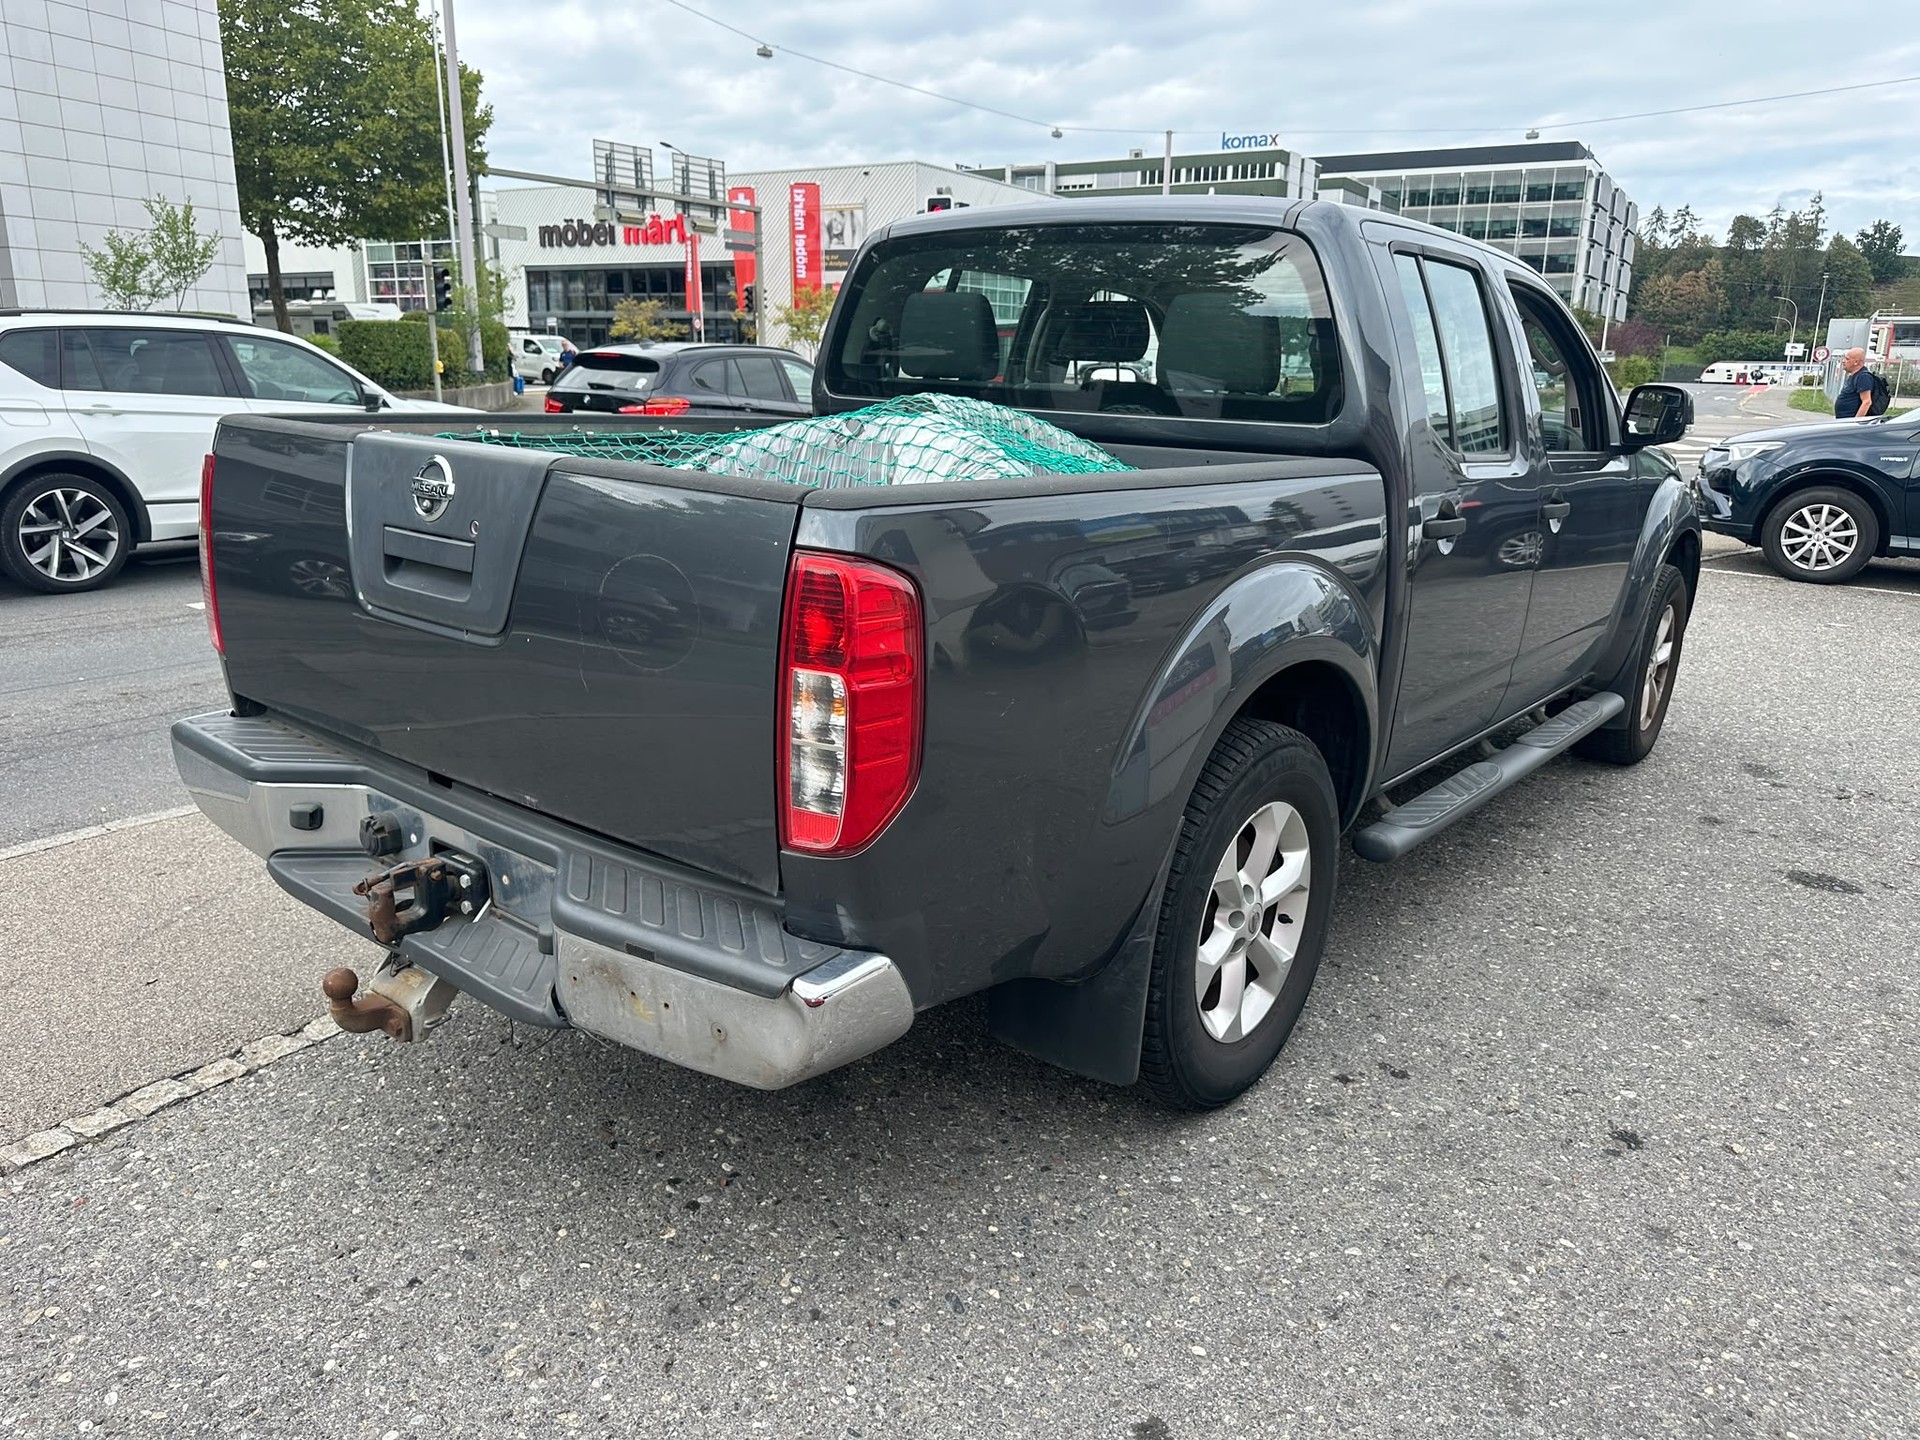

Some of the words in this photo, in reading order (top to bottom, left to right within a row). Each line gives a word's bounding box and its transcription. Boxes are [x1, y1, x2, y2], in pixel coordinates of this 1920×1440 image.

[1221, 131, 1279, 150] komax
[793, 188, 806, 231] märki
[623, 214, 700, 245] märk
[795, 234, 808, 279] möbel
[411, 481, 447, 498] NISSAN
